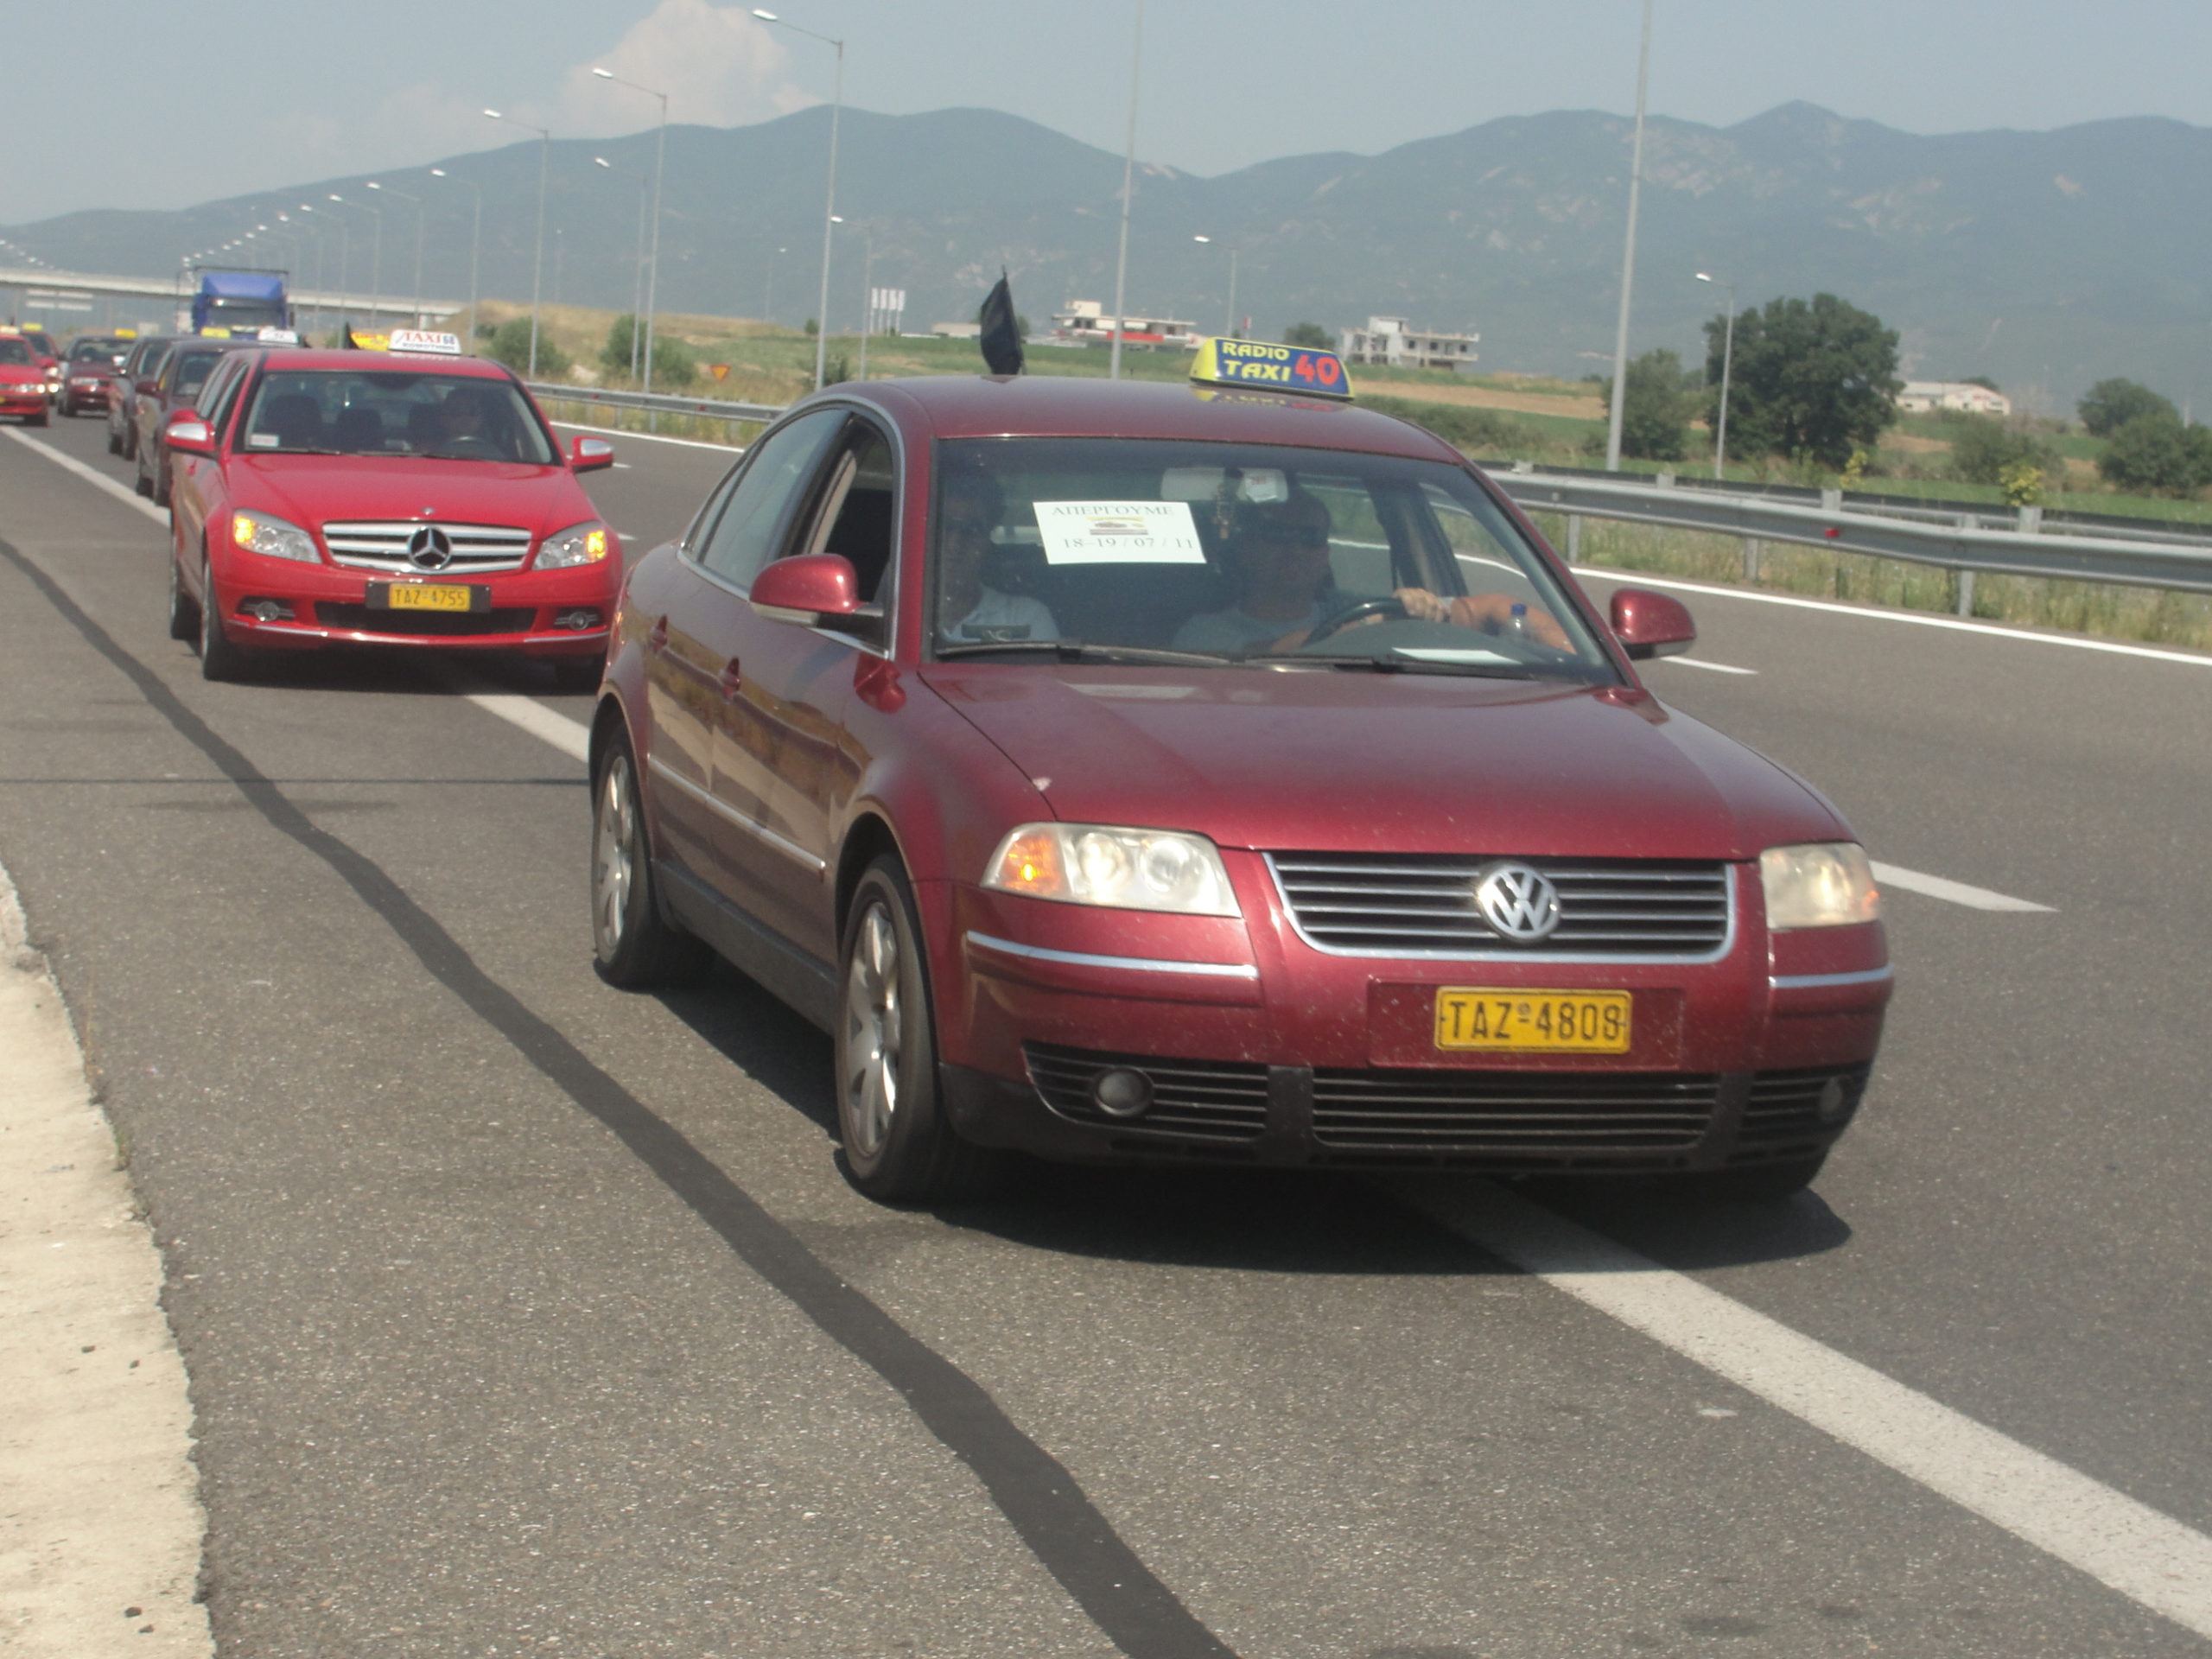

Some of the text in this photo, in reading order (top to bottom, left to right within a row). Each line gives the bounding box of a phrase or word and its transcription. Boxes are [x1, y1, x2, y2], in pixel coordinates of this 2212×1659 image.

[404, 332, 441, 344] TAXI
[1222, 341, 1290, 360] RADIO
[1224, 354, 1341, 385] TAXI 40
[1052, 505, 1173, 516] ΑΠΕΡΓΟΥΜΕ
